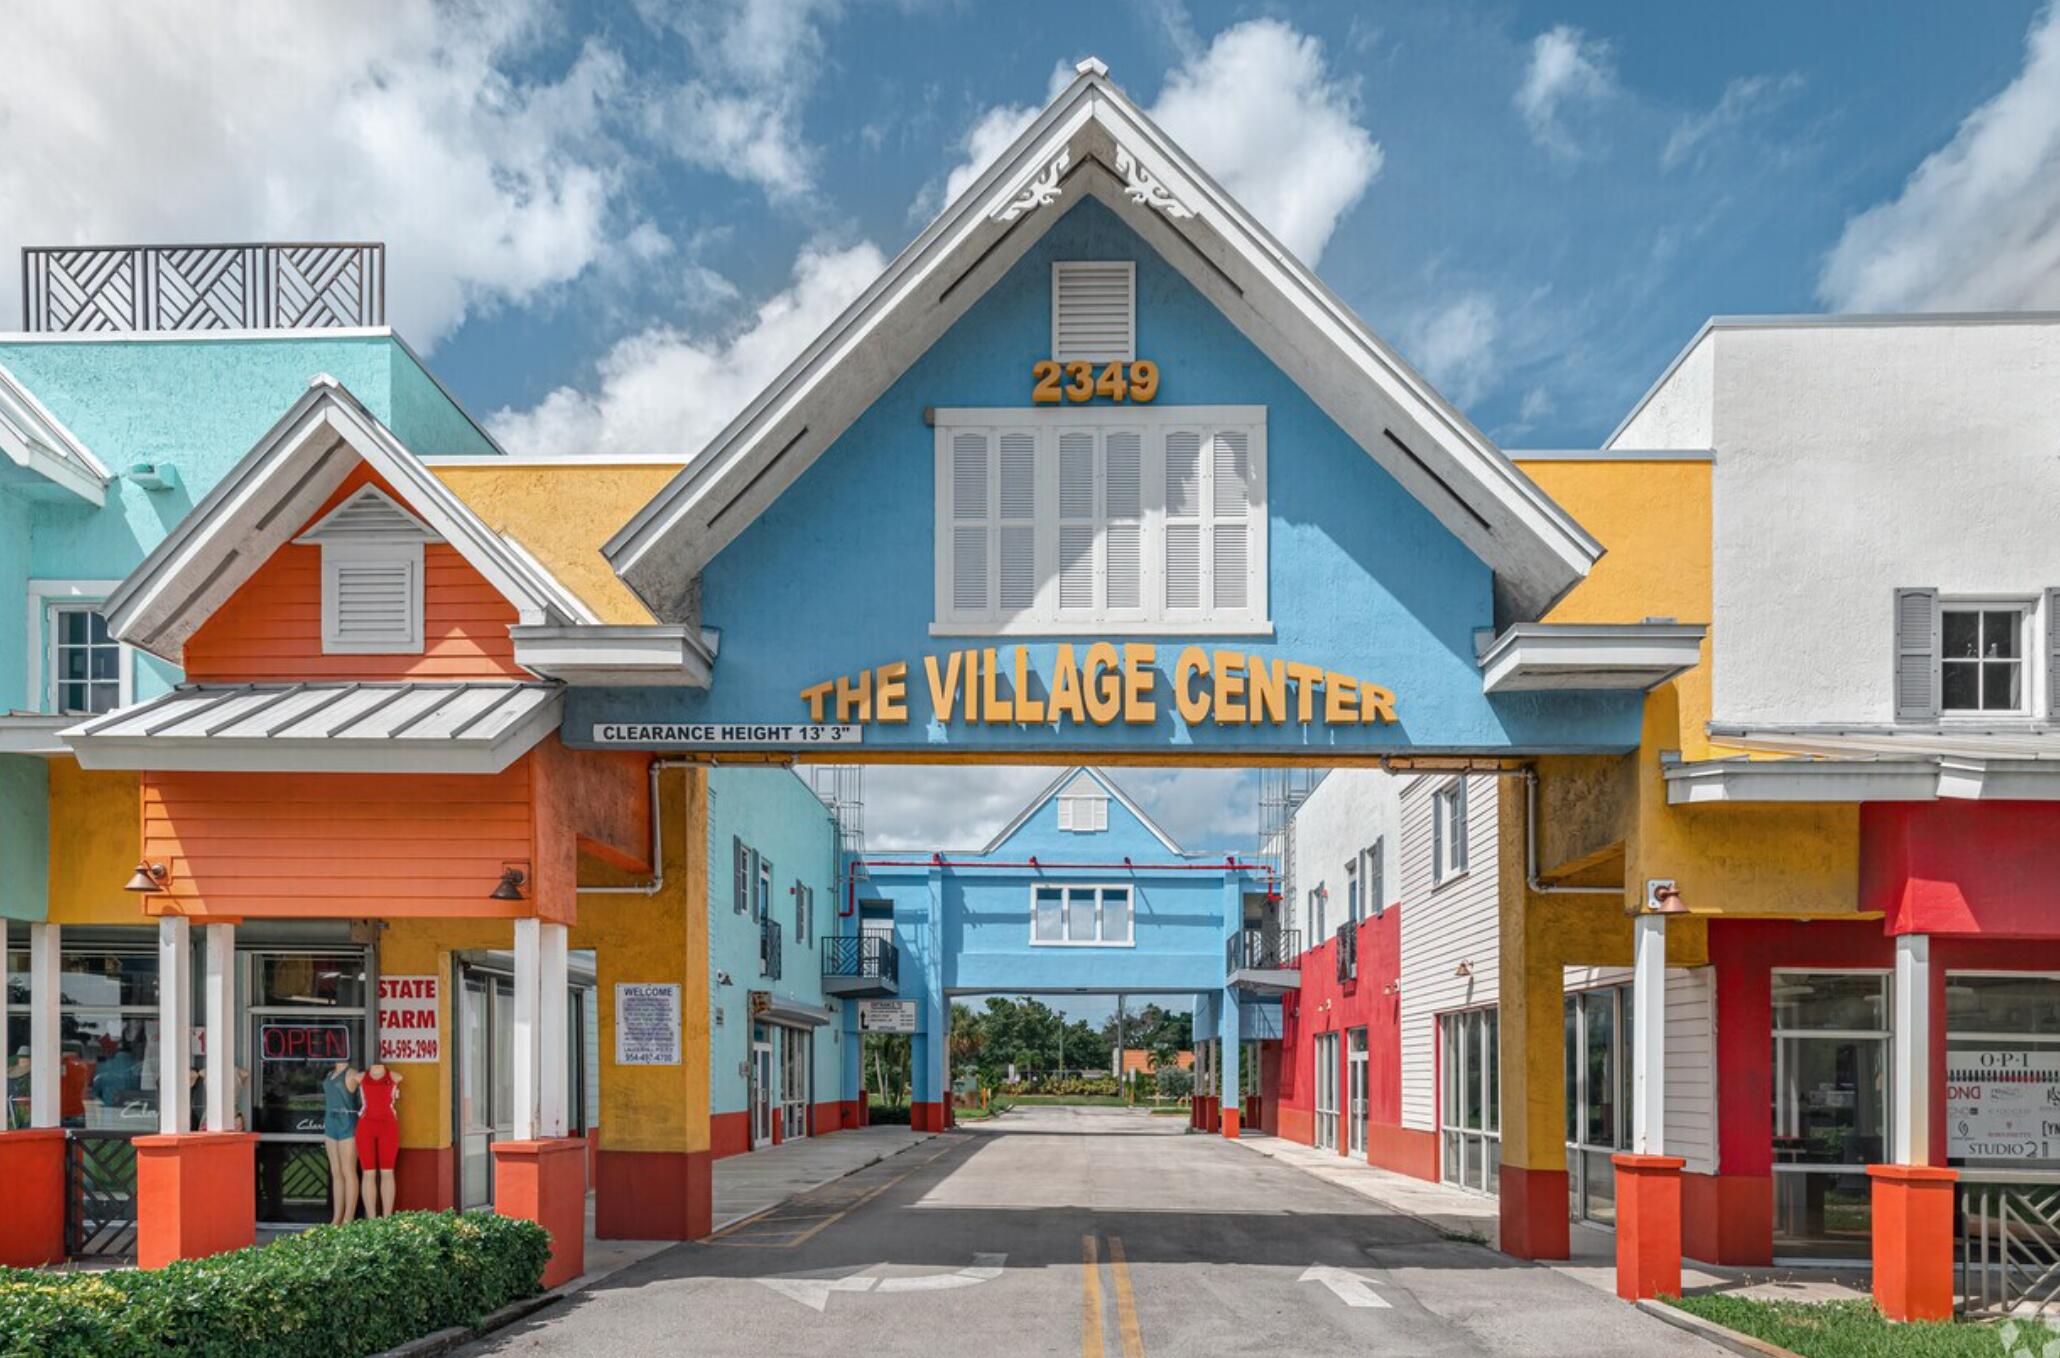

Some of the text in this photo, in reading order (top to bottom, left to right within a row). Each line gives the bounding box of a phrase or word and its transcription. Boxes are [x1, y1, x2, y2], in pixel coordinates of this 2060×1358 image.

[1032, 360, 1159, 402] 2349
[800, 642, 1400, 725] THE VILLAGE CENTER
[603, 726, 851, 741] CLEARANCE HEIGHT 13' 3"
[379, 980, 436, 999] STATE
[624, 986, 674, 997] WELCOME
[379, 1010, 436, 1029] FARM
[263, 1027, 348, 1058] OPEN
[379, 1039, 437, 1059] 54-595-2949
